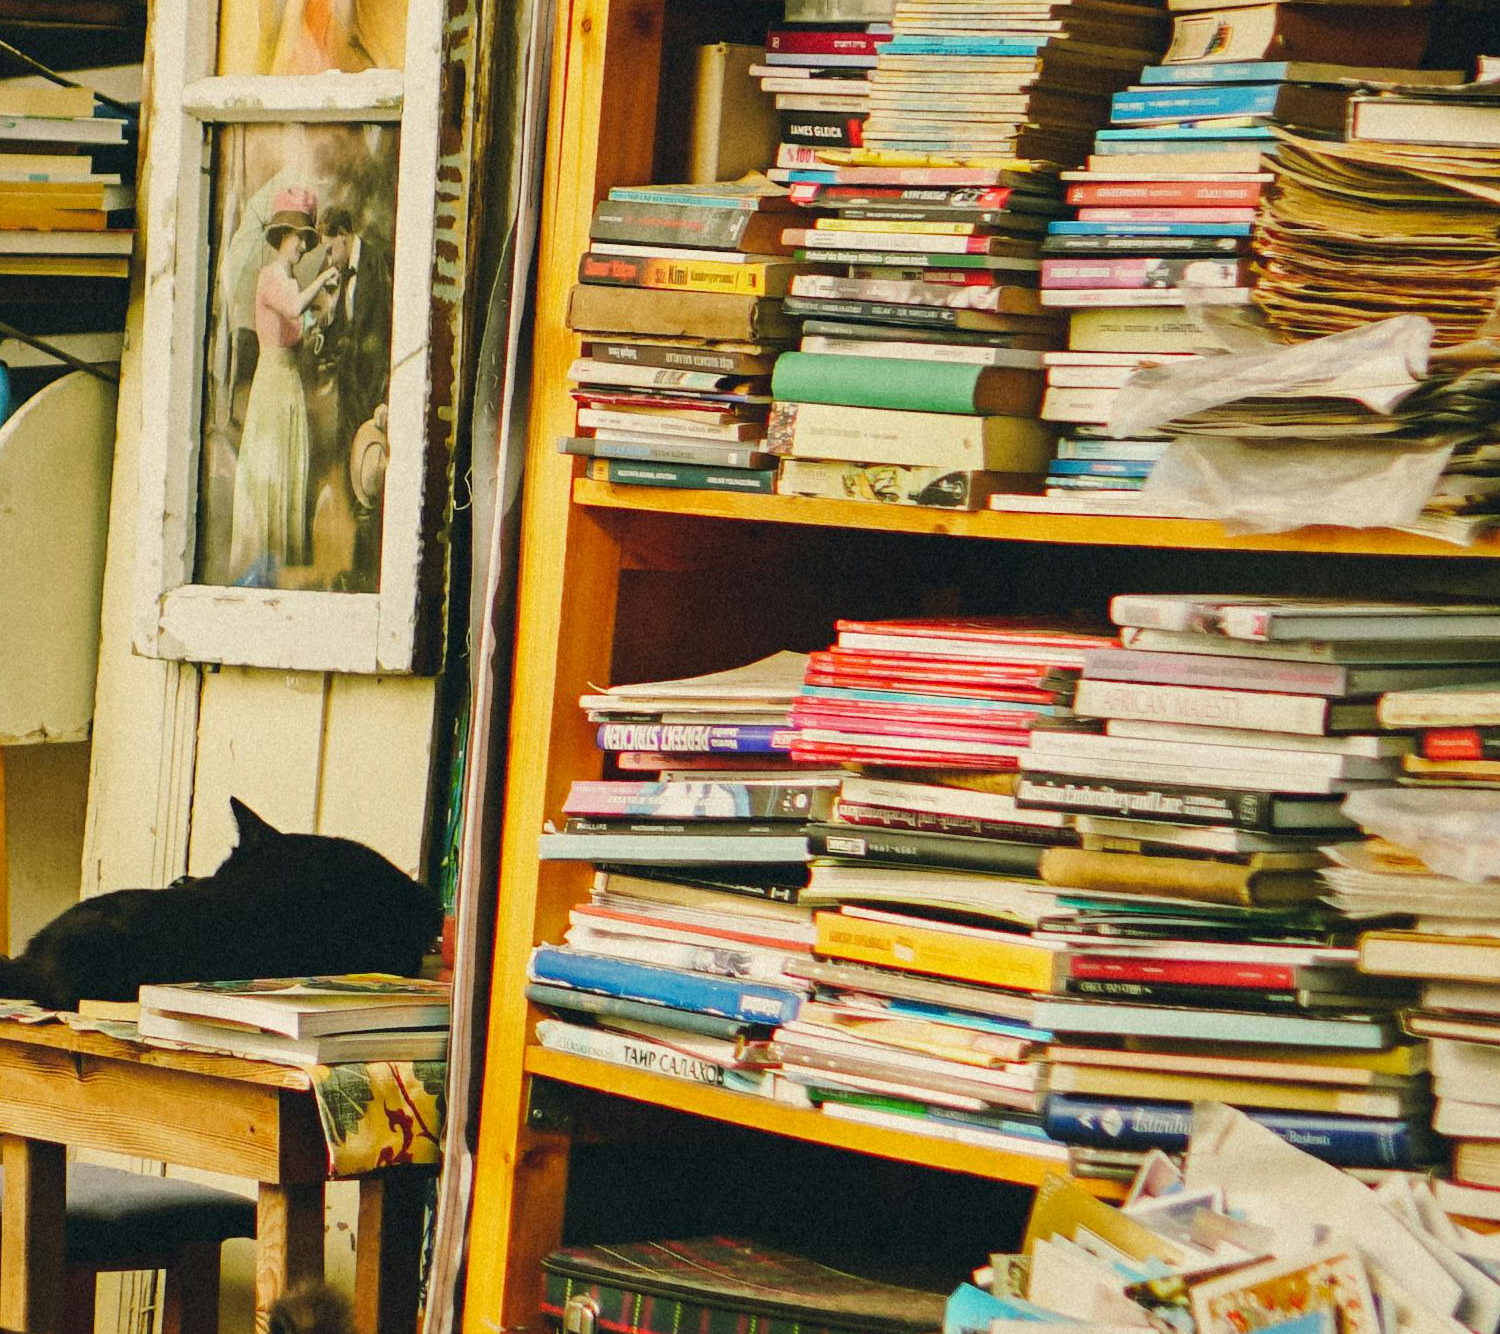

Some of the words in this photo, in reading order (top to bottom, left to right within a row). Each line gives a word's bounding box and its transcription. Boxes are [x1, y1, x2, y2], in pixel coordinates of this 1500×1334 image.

[790, 124, 814, 137] JAMES
[603, 724, 660, 751] STRICKEN
[660, 725, 711, 752] PERFEKT
[623, 1044, 657, 1067] ТАИР
[657, 1054, 725, 1086] САЛАХОВ
